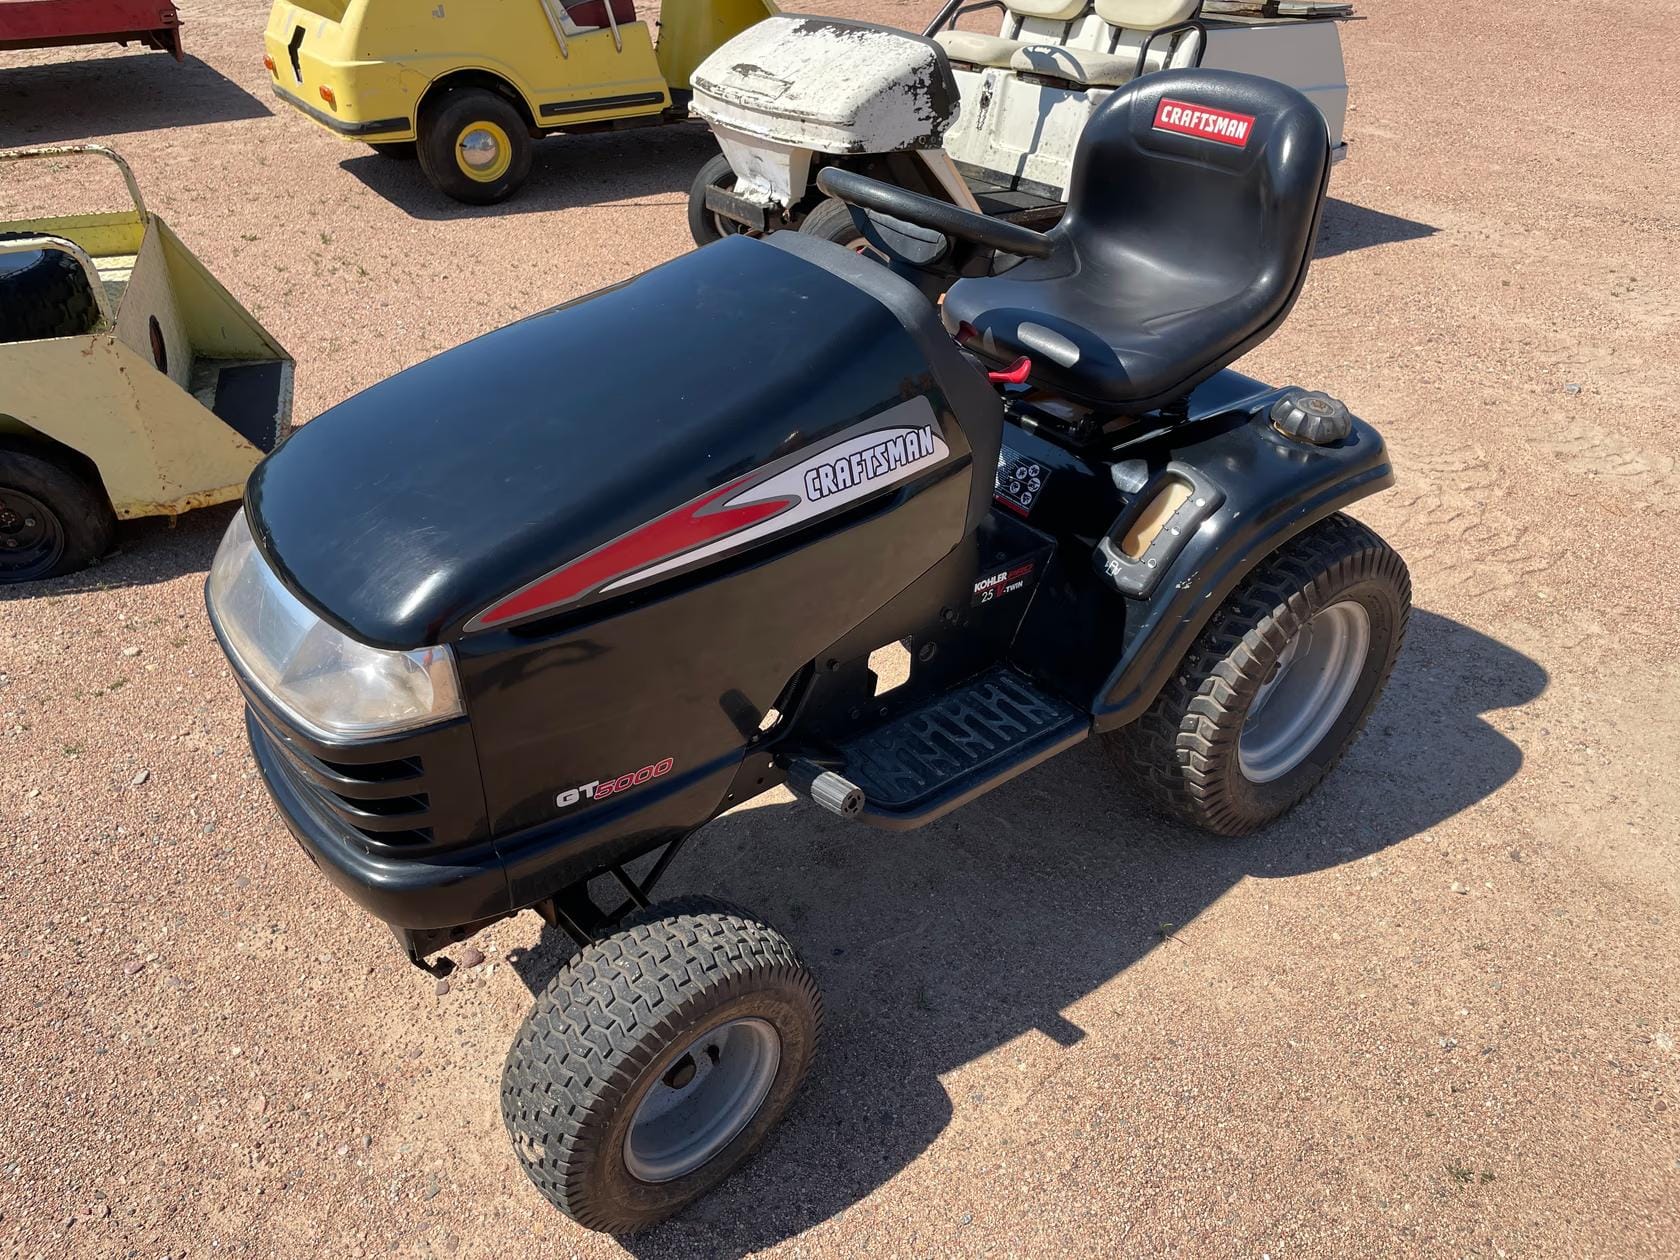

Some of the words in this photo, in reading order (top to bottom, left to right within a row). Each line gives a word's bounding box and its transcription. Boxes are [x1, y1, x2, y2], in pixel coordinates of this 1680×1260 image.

[1161, 105, 1248, 139] CRAFTSMAN
[804, 424, 934, 502] CRAFTSMAN
[974, 571, 1008, 593] KOHLER
[981, 588, 994, 603] 25
[556, 757, 674, 808] GT5000
